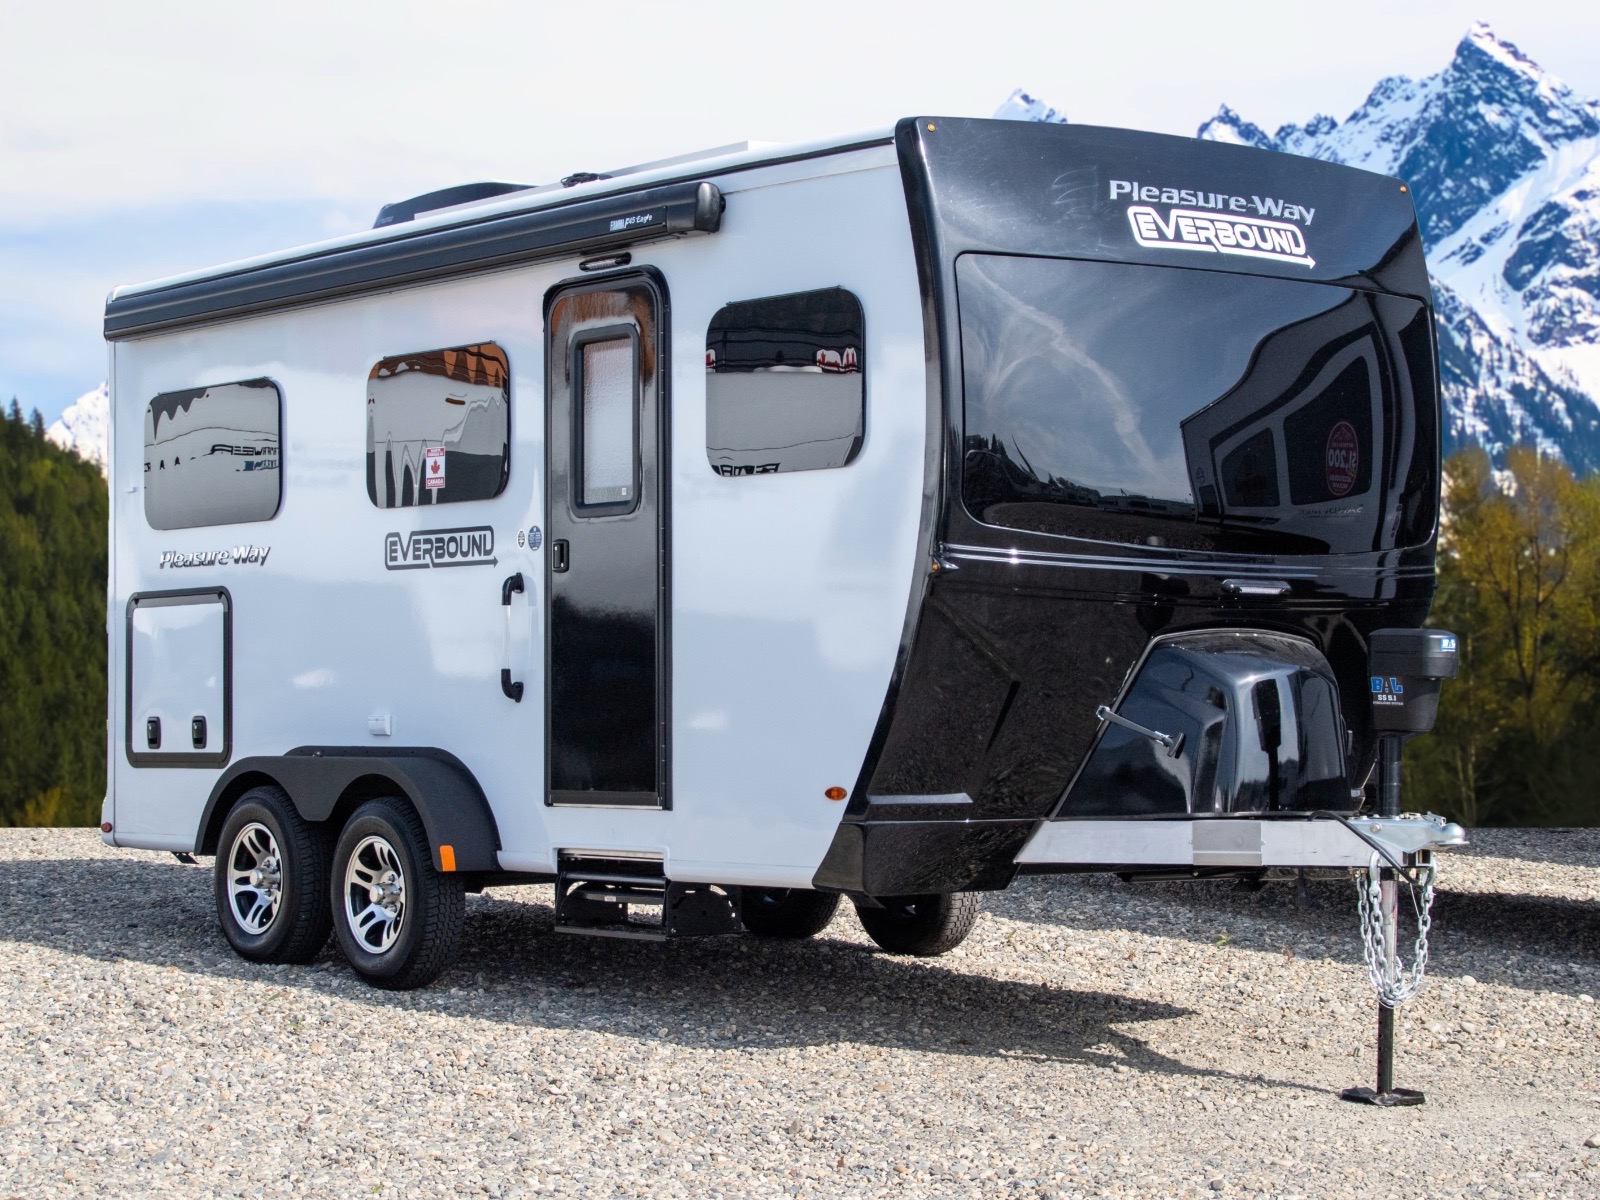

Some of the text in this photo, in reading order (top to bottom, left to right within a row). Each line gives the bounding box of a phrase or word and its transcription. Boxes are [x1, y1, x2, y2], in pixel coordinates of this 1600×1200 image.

[1109, 179, 1316, 226] Pleasure-Way
[1132, 207, 1309, 258] EVERBOUND
[387, 528, 496, 564] EVERBOUND
